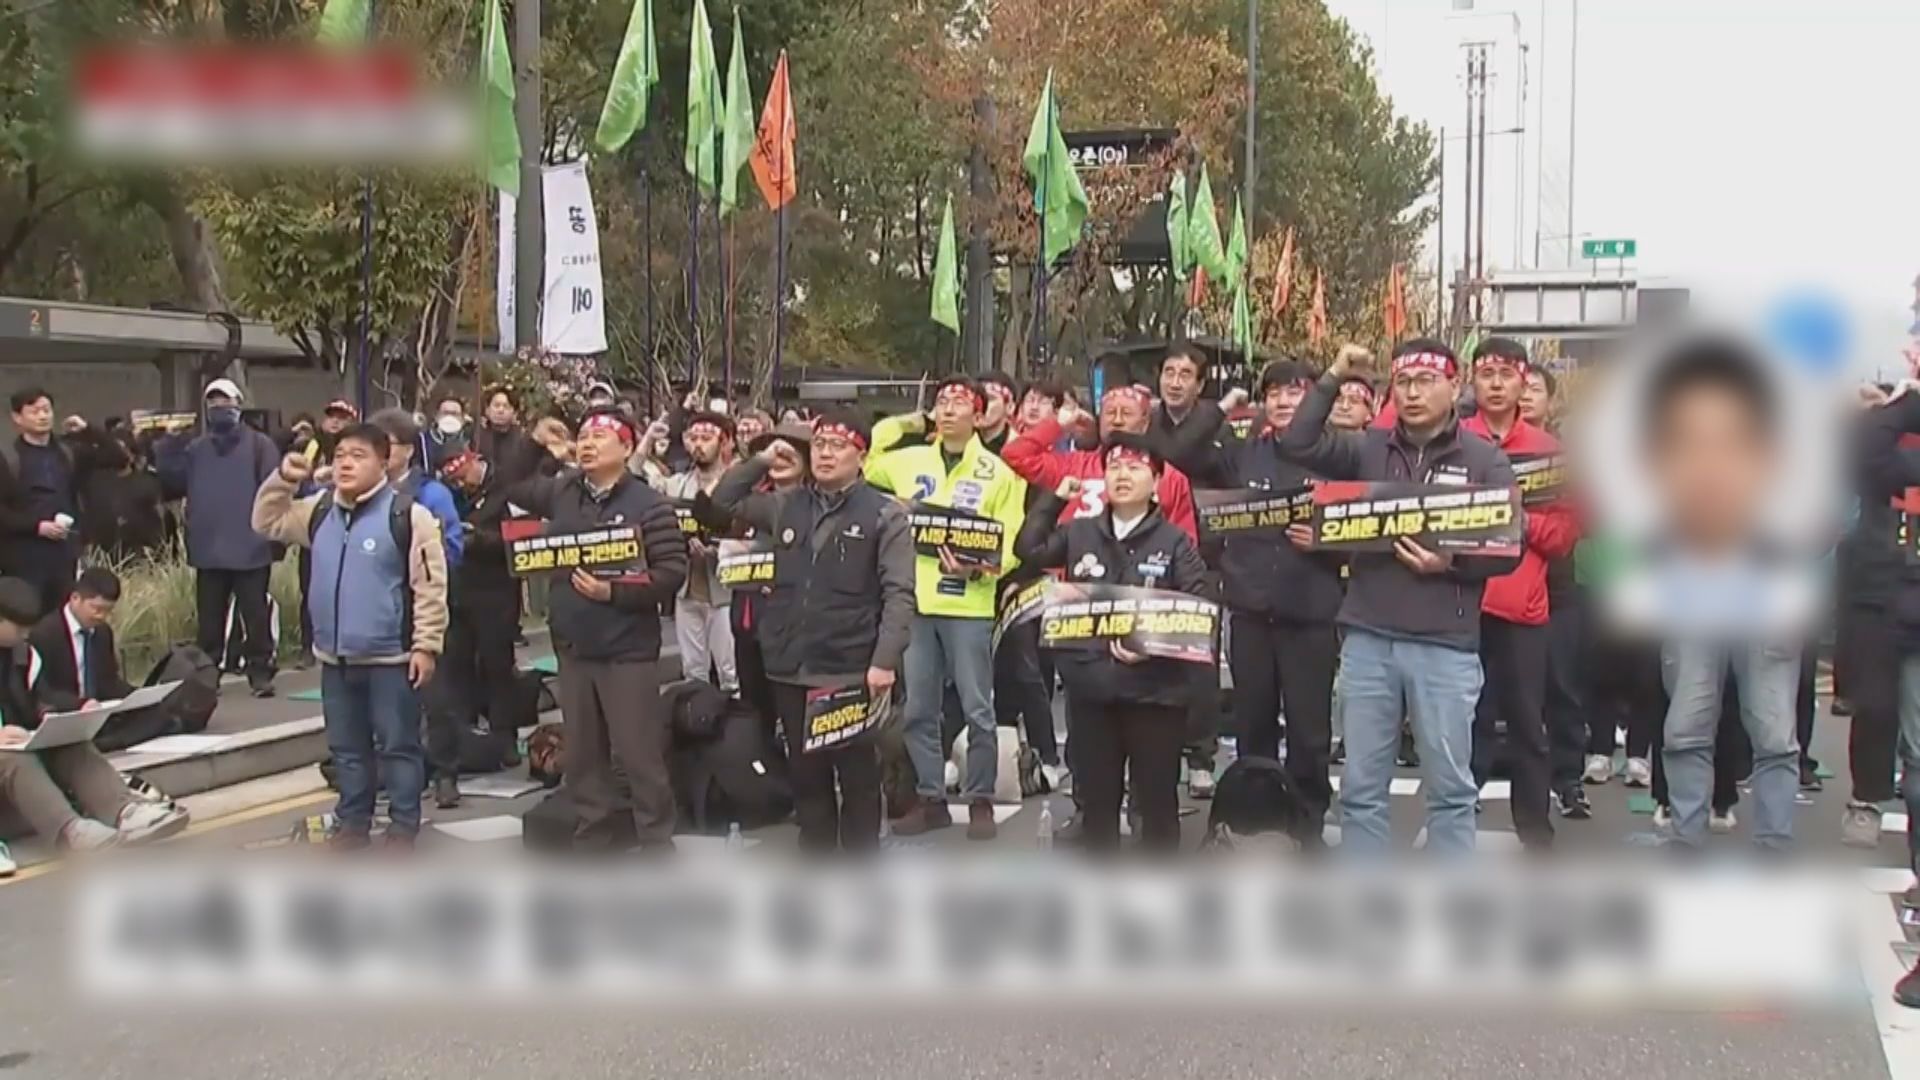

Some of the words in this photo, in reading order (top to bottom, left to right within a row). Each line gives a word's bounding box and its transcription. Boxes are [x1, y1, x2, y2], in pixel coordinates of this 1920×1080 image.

[31, 309, 40, 325] 2
[973, 456, 996, 480] 2
[1073, 478, 1106, 519] 3
[1320, 516, 1379, 542] 오세훈
[1382, 511, 1425, 536] 시장
[1428, 503, 1513, 532] 규탄한다
[514, 550, 555, 572] 오세훈
[557, 546, 580, 567] 시장
[582, 540, 639, 565] 규탄한다
[1044, 616, 1094, 640] 오세훈
[1096, 613, 1135, 636] 시장
